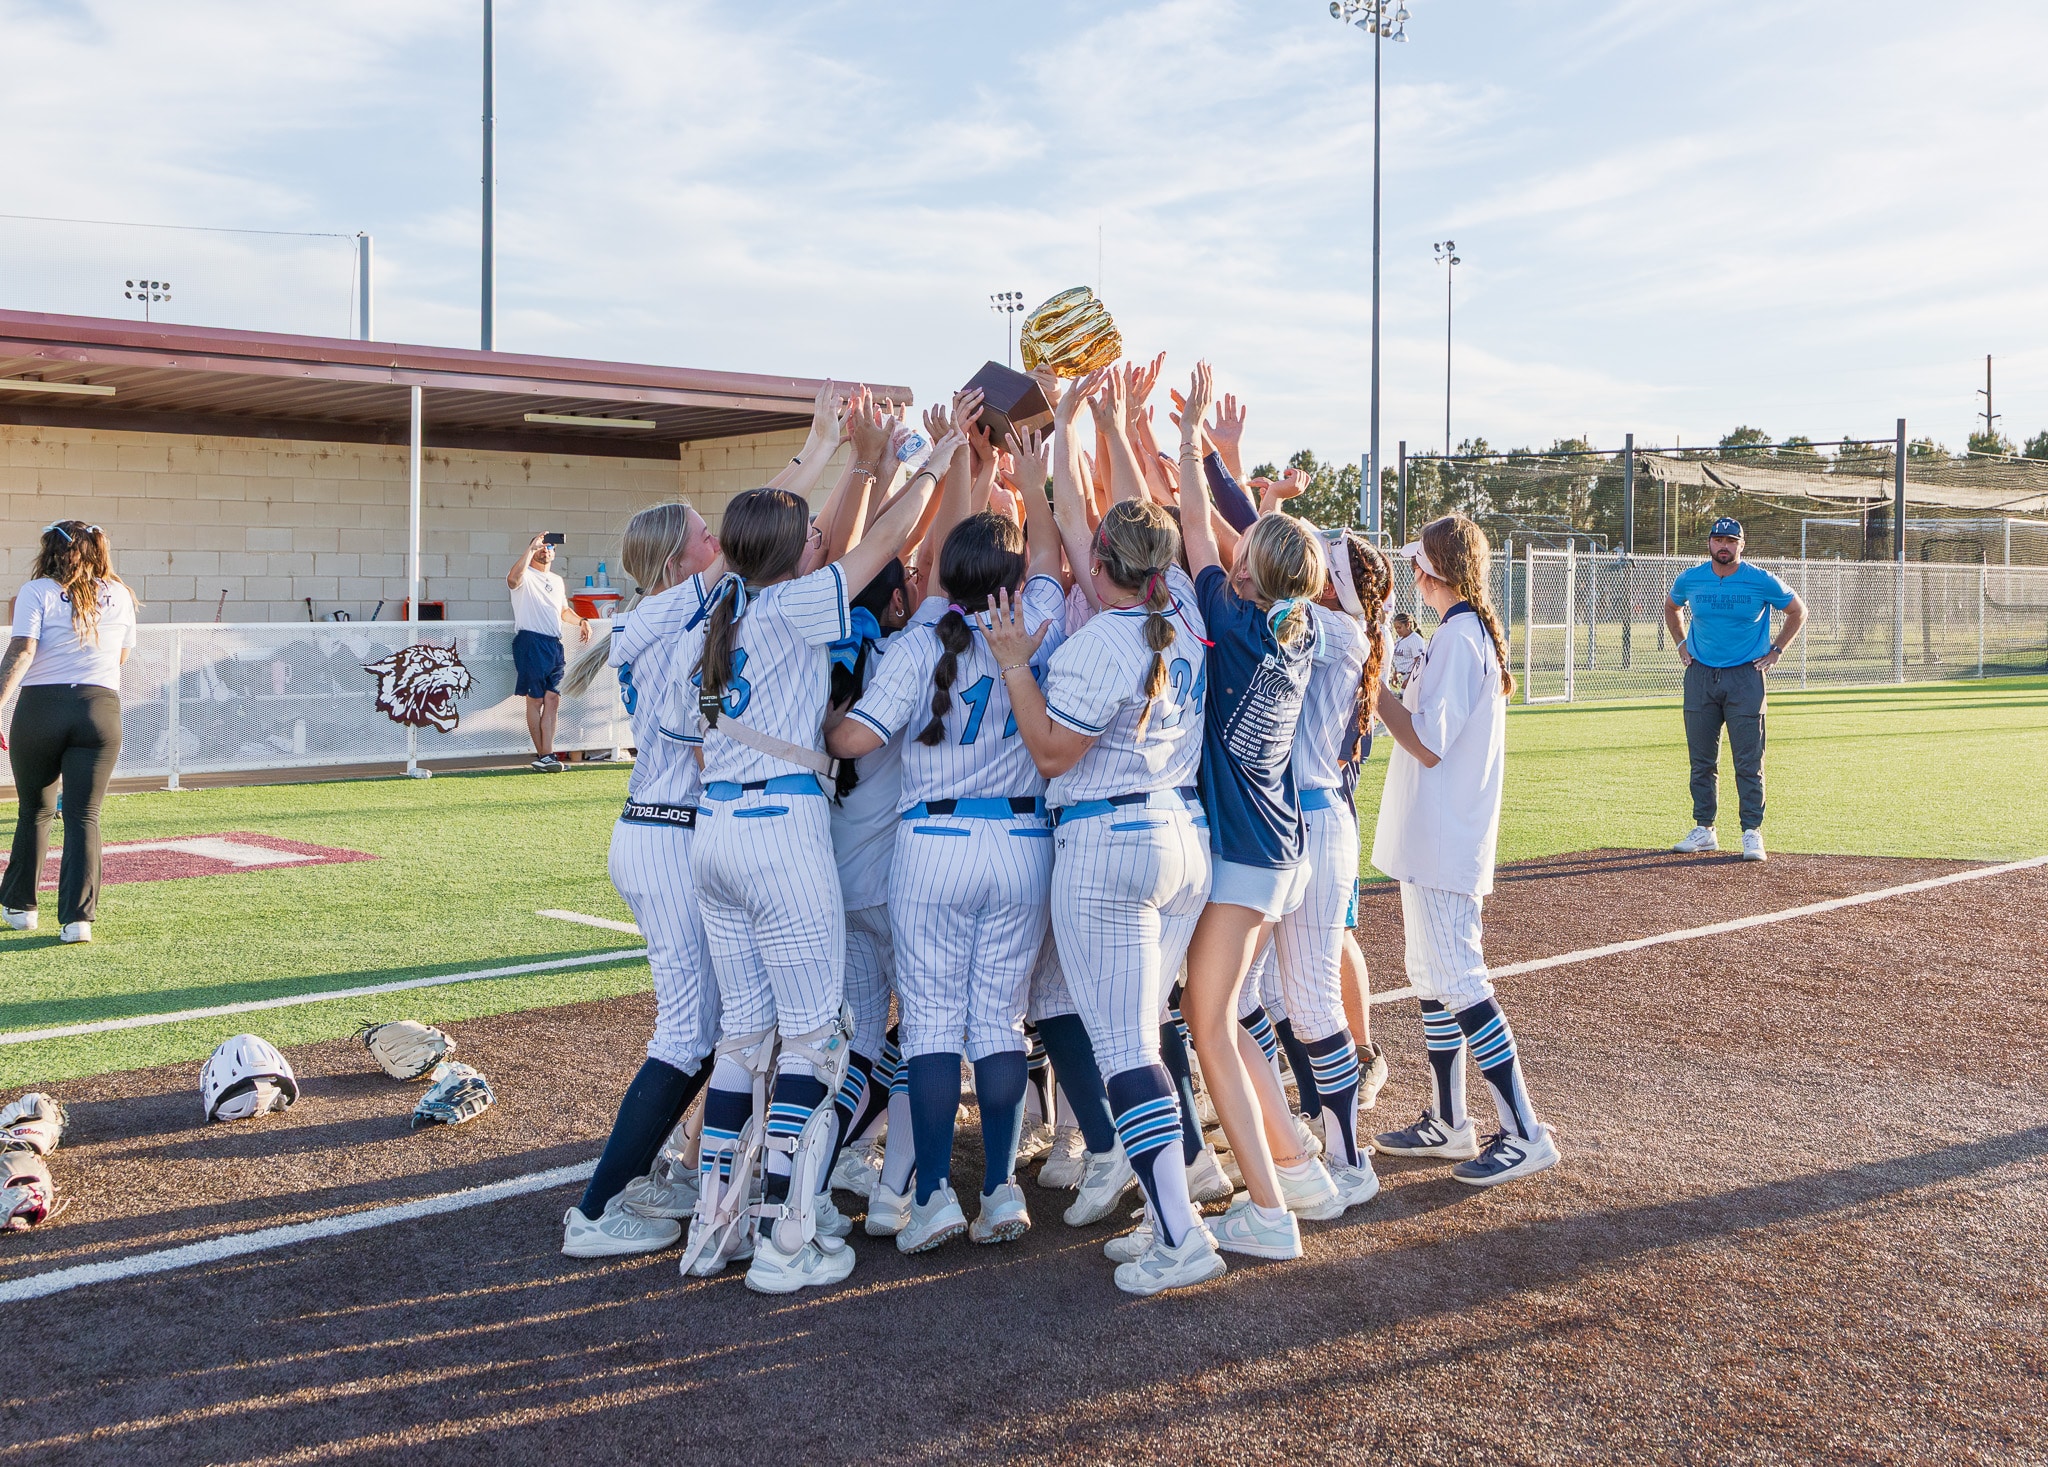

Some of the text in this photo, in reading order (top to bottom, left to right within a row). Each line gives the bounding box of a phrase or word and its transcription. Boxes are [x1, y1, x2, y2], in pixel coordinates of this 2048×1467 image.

[1161, 644, 1207, 730] 24
[631, 805, 691, 823] SOFTBALL
[13, 1128, 44, 1137] Wilson
